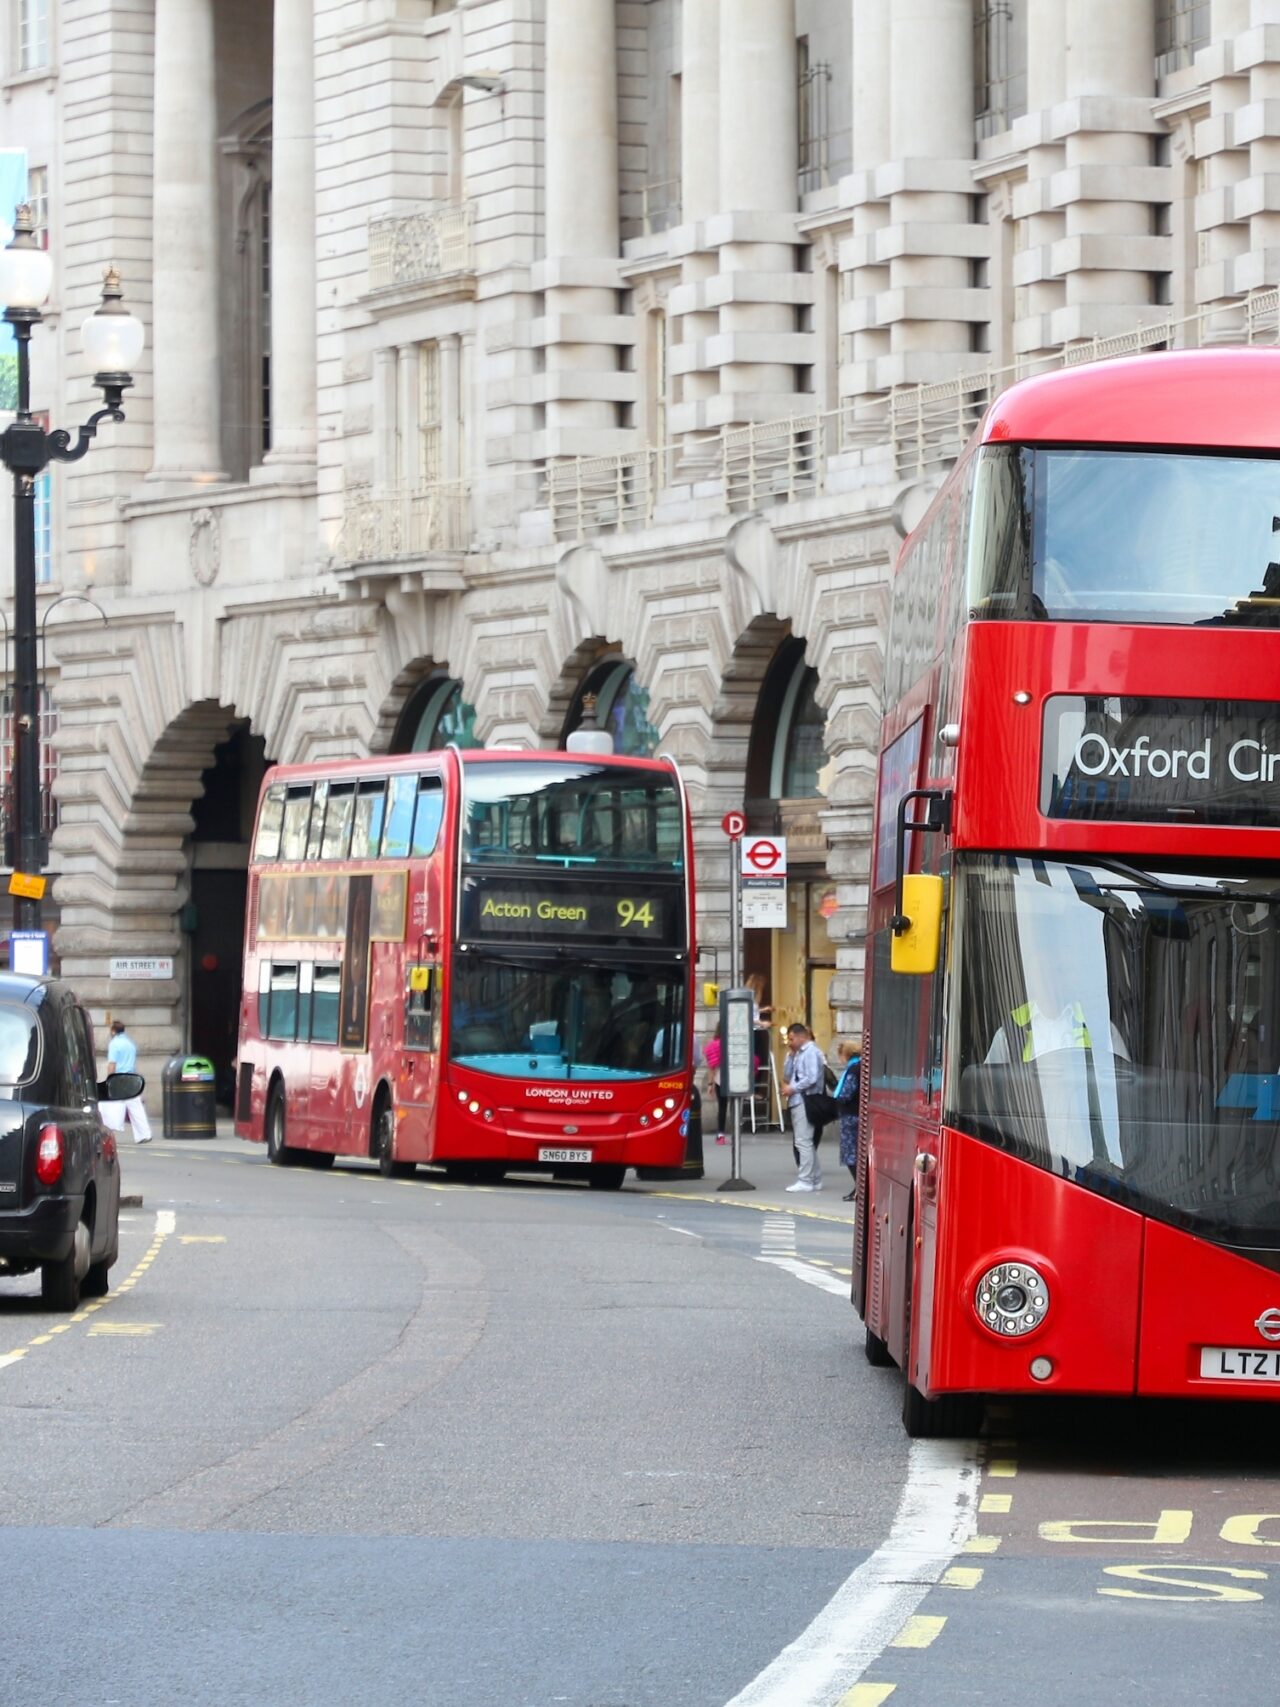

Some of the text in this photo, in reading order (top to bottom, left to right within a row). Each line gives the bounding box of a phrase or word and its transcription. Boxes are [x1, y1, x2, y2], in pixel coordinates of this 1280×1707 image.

[1073, 732, 1211, 780] Oxford
[729, 816, 744, 834] D
[481, 898, 587, 920] Acton Green
[616, 900, 655, 929] 94
[115, 961, 128, 969] AIR
[129, 961, 156, 970] STREET
[525, 1088, 614, 1100] LONDON UNITED
[542, 1151, 588, 1161] SN60 BYS
[1220, 1351, 1269, 1376] LTZ
